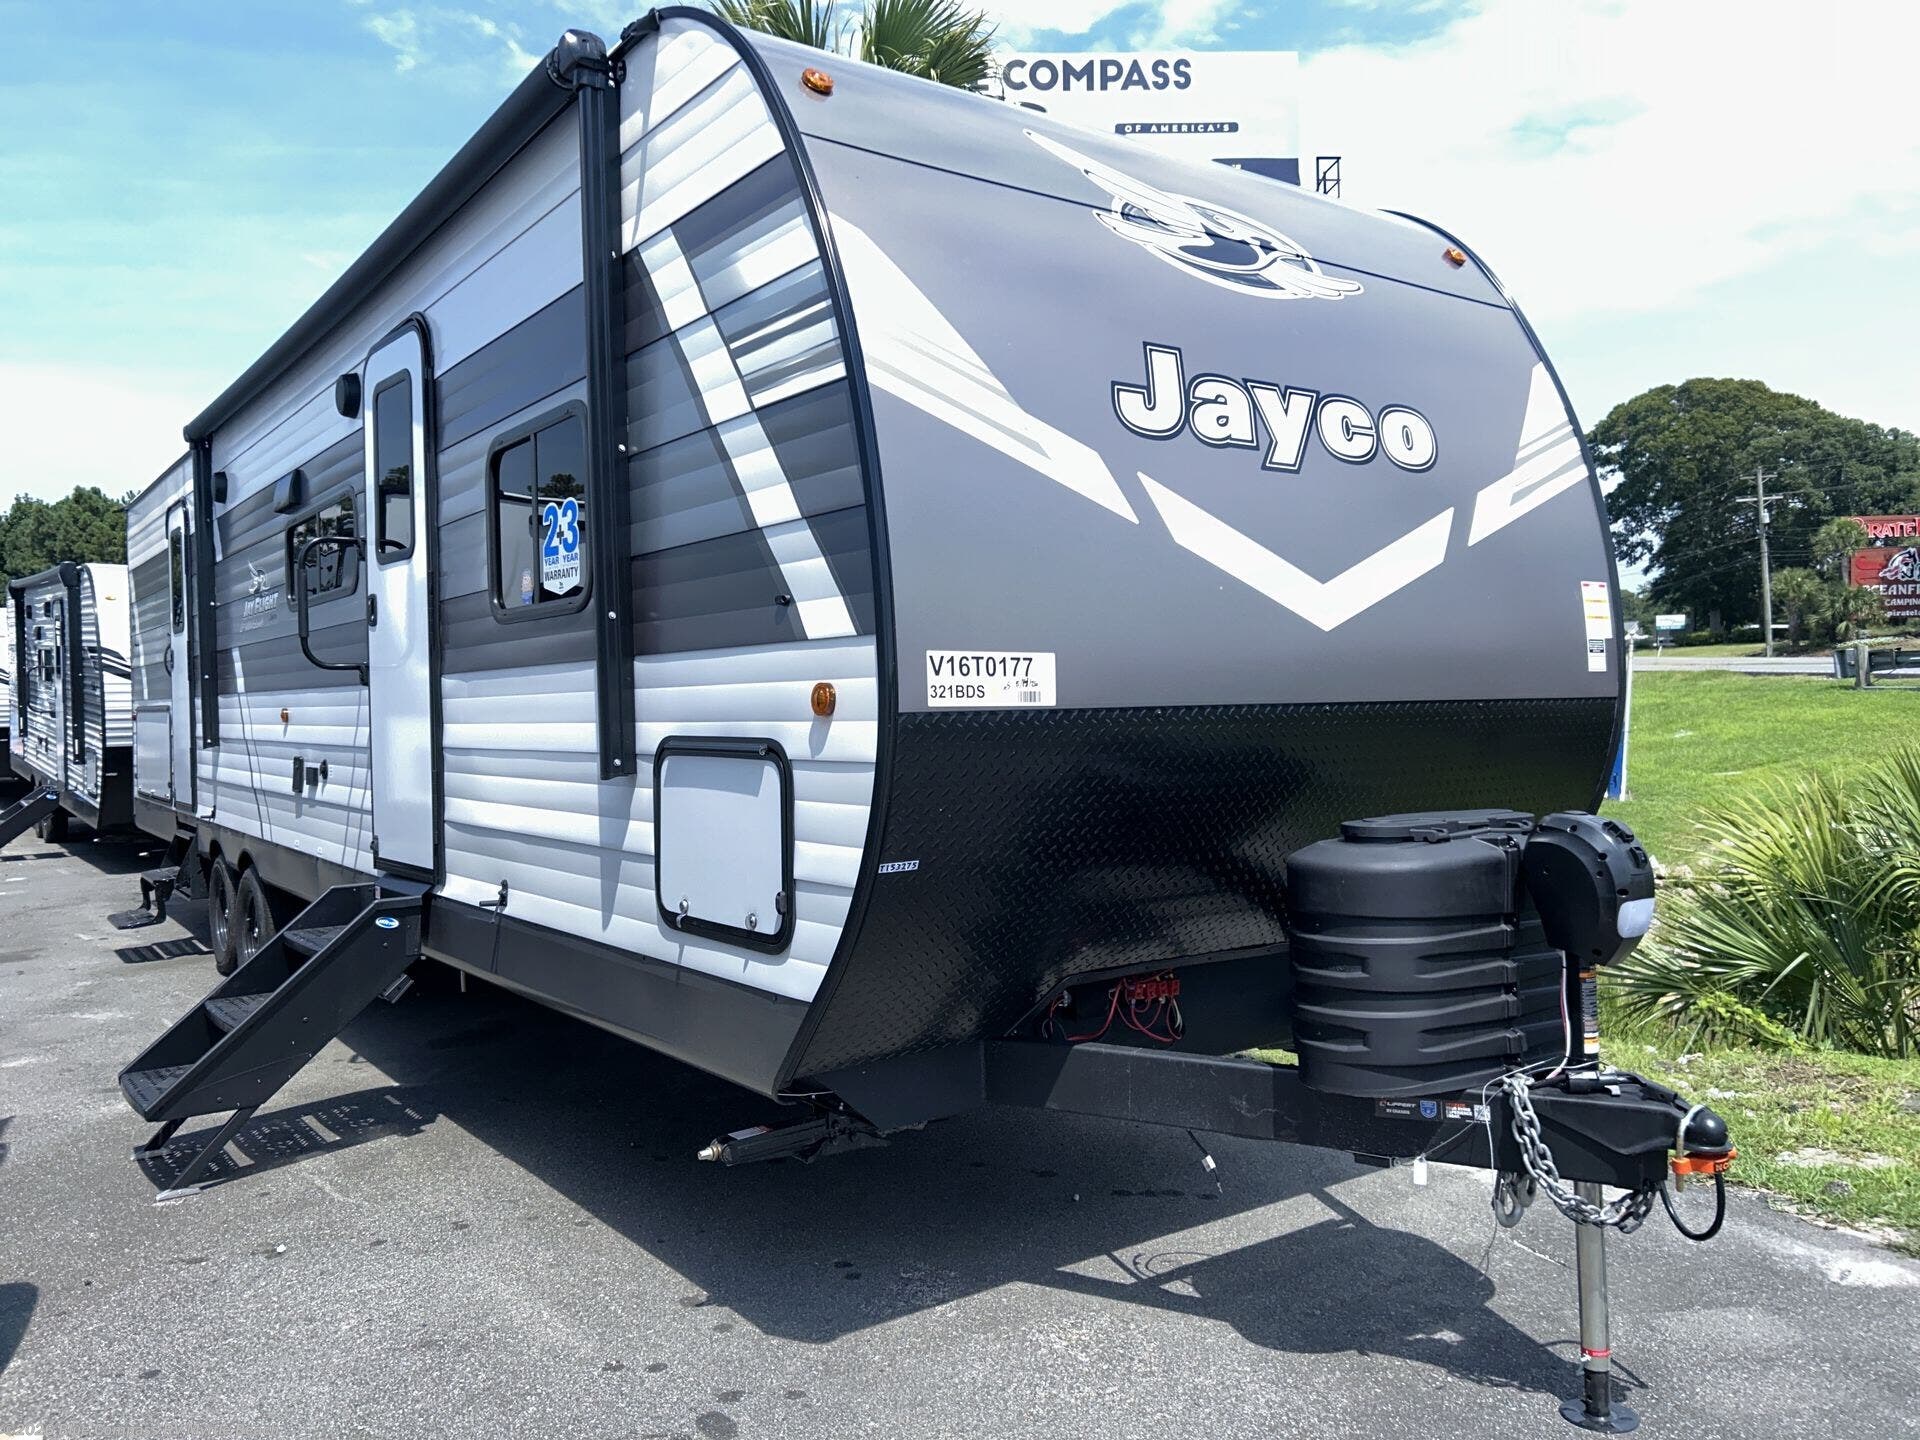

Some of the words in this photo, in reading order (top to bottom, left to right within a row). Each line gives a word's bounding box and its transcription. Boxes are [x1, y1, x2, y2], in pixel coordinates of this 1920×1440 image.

[1002, 59, 1192, 91] COMPASS
[1124, 124, 1142, 133] OF
[1150, 123, 1230, 133] AMERICA'S
[1110, 341, 1438, 474] Jayco
[544, 556, 560, 567] YEAR
[562, 552, 579, 563] YEAR
[544, 567, 579, 582] WARRANTY
[929, 655, 1033, 677] V16T0177
[930, 685, 985, 699] 321BDS
